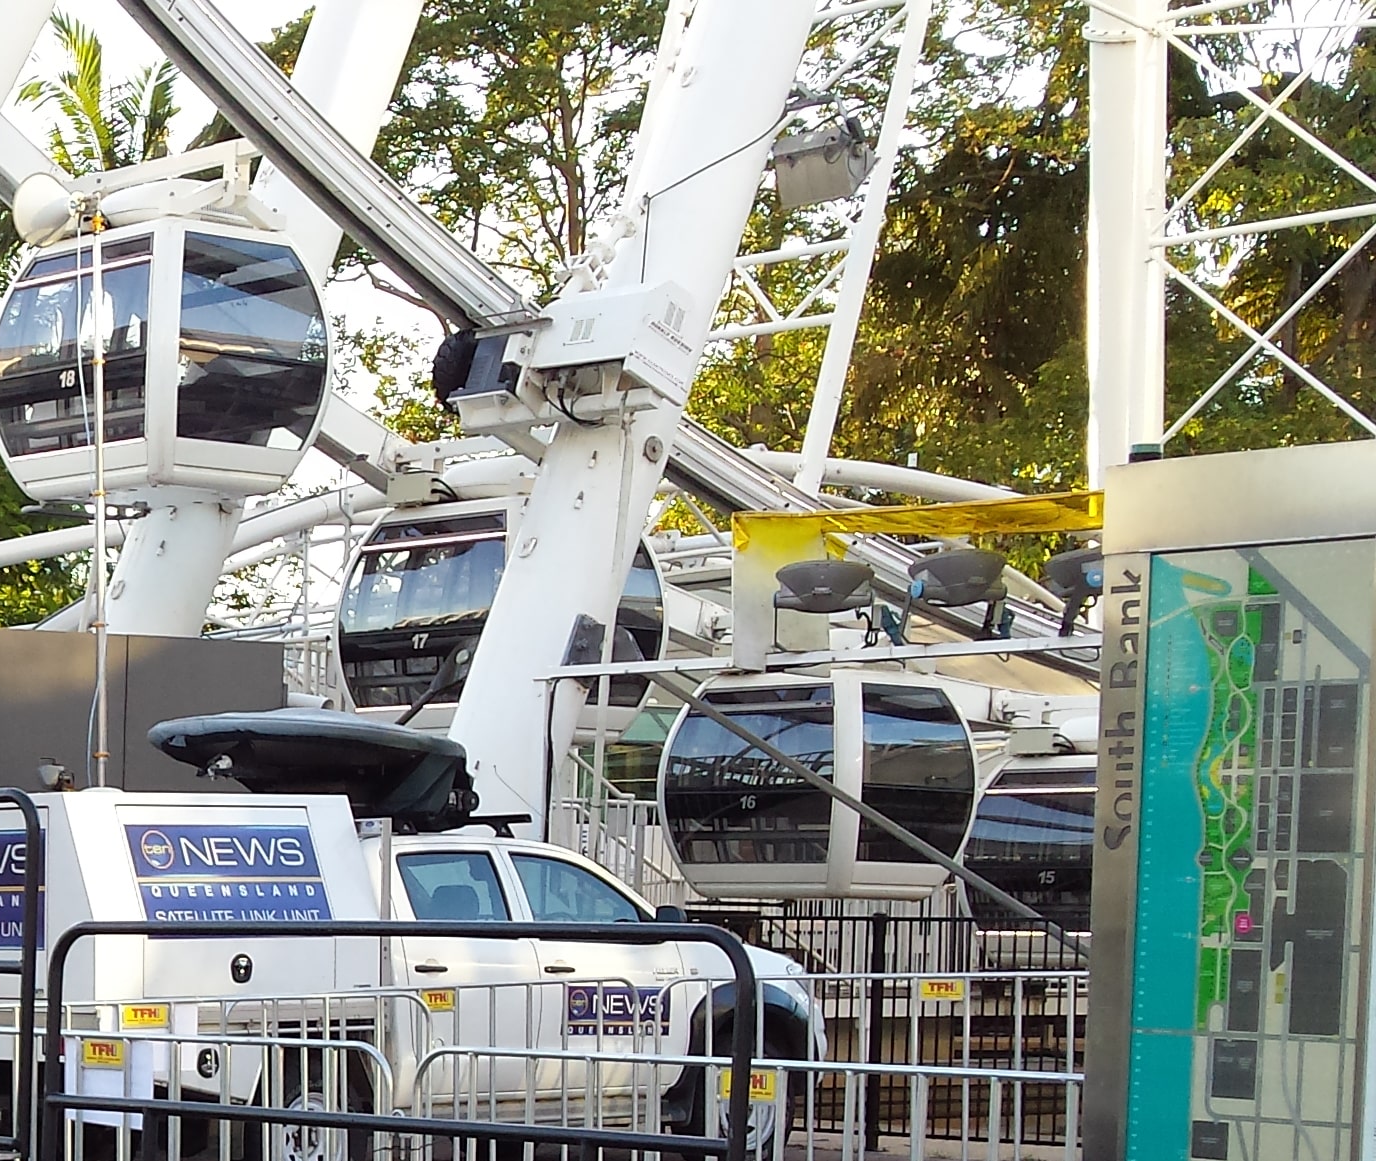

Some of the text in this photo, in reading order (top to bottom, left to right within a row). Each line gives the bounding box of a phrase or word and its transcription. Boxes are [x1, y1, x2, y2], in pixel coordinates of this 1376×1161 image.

[59, 370, 76, 388] 18
[411, 633, 429, 649] 17
[1104, 569, 1141, 850] South Bank
[740, 795, 757, 810] 16
[179, 837, 305, 867] NEWS
[1038, 870, 1056, 884] 15
[151, 884, 315, 898] QUEENSLAND
[155, 910, 320, 921] SATELLITE LINK UNIT
[1, 921, 23, 937] UN
[928, 982, 953, 992] TFH
[427, 993, 447, 1003] TFH
[592, 994, 663, 1015] NEWS
[131, 1008, 156, 1018] TFH
[90, 1043, 114, 1056] TFH
